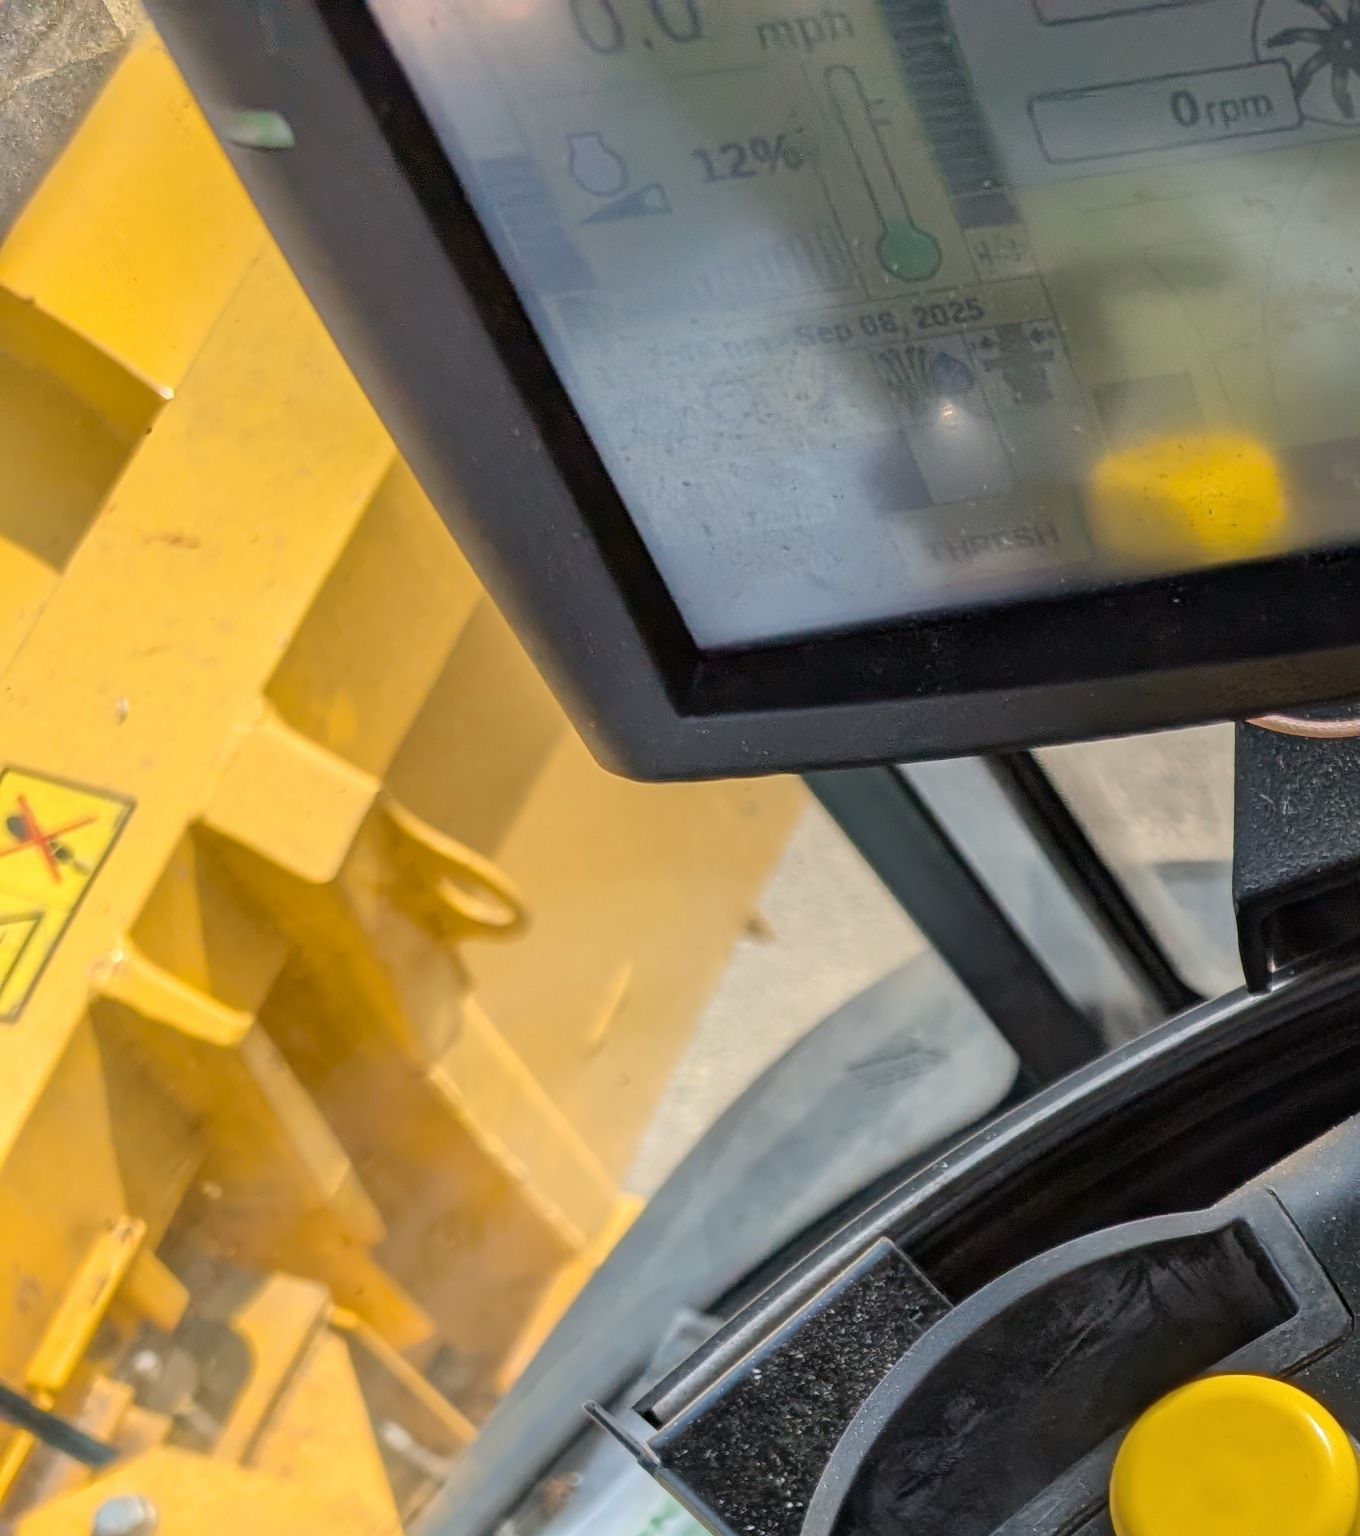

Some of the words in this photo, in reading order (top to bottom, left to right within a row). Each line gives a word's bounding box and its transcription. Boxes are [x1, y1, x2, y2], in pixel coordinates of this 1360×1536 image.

[756, 9, 853, 52] mph
[1170, 90, 1200, 127] 0
[1204, 95, 1273, 128] rpm
[693, 128, 806, 182] 12%
[795, 321, 852, 347] Sep
[911, 298, 985, 330] 2025
